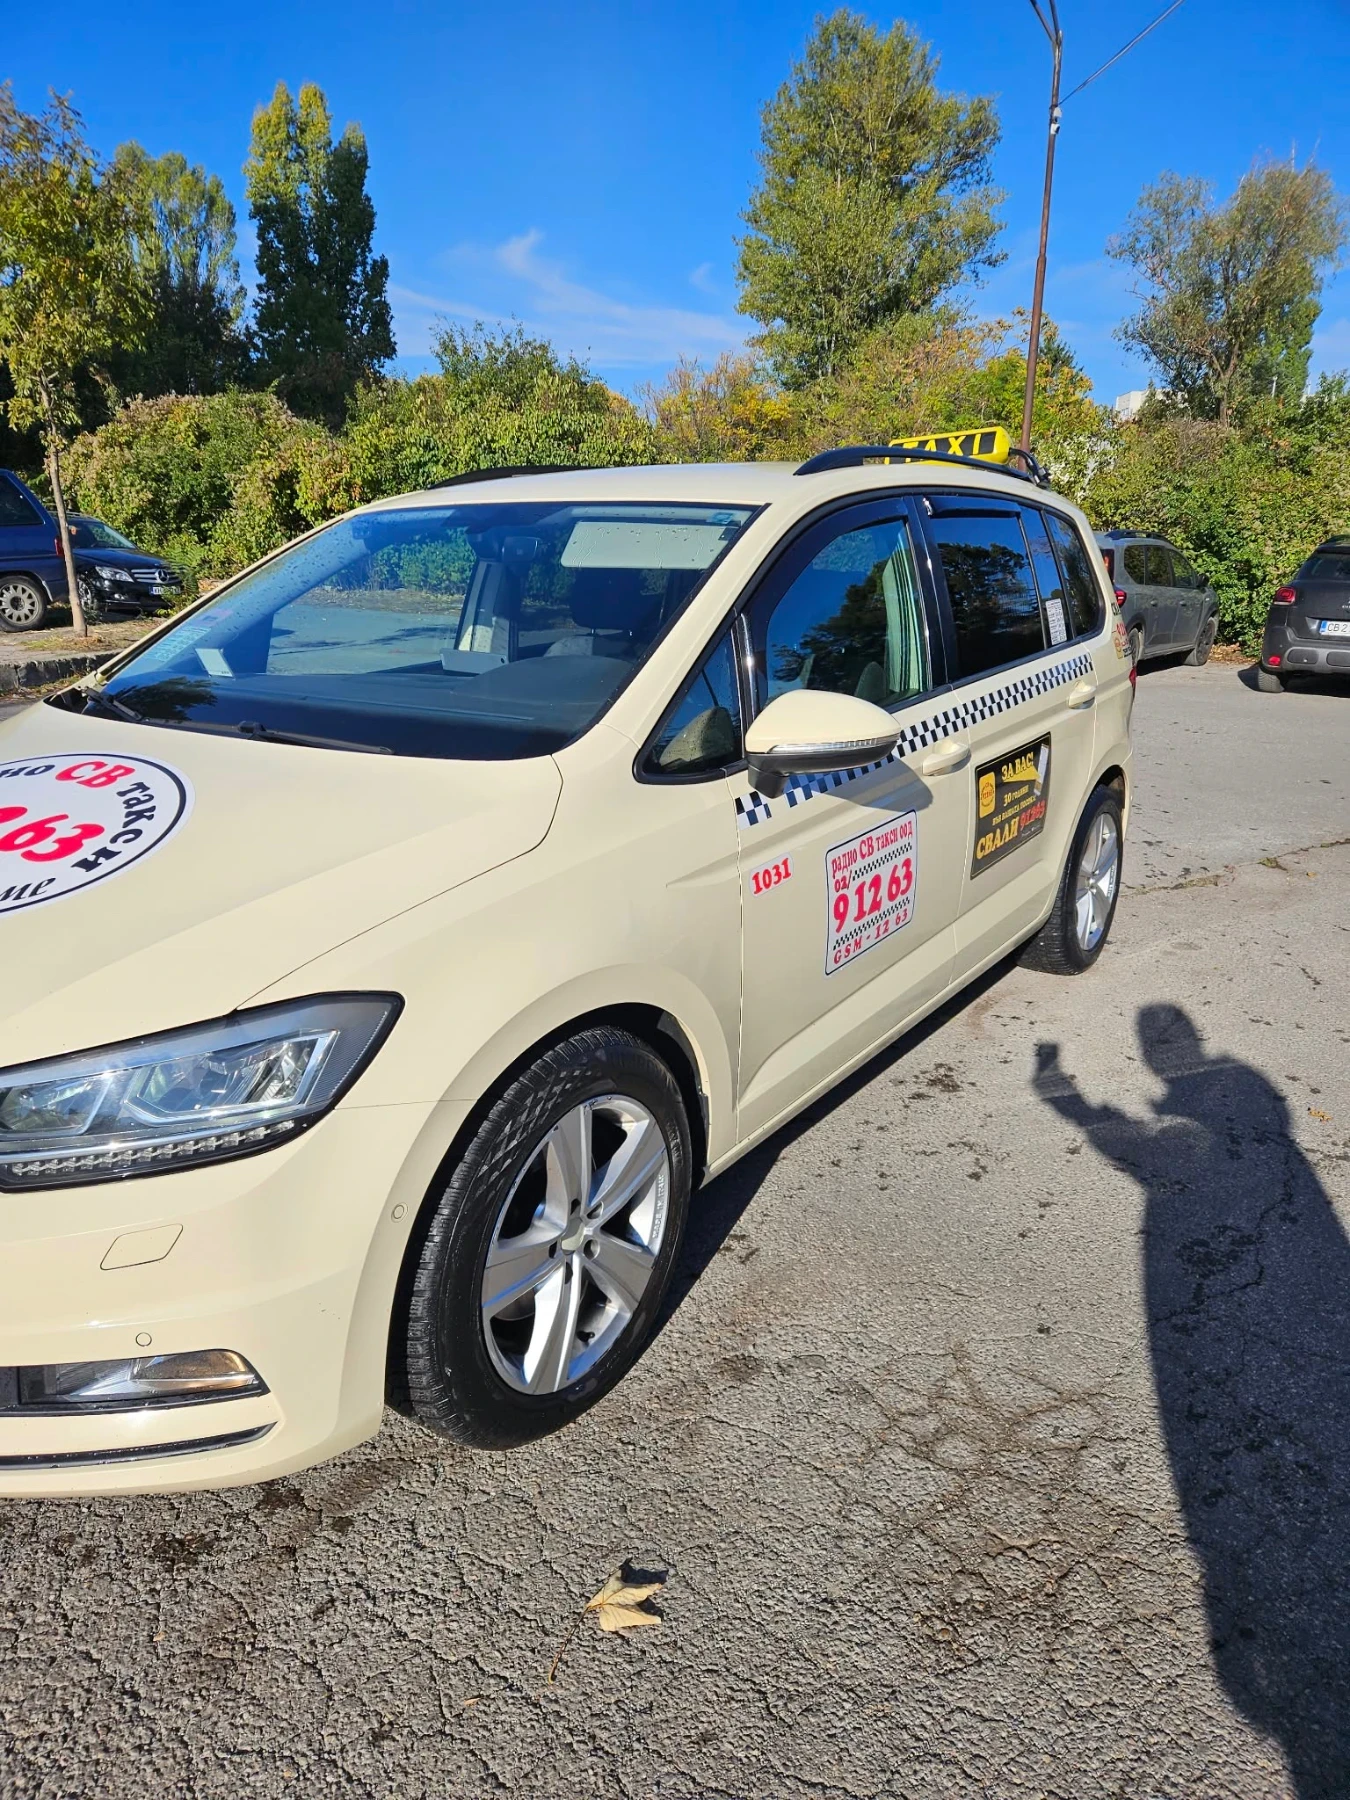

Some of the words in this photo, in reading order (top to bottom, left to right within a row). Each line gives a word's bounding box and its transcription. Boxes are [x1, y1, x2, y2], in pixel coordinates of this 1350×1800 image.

[1001, 762, 1013, 781] ЗА
[976, 816, 1020, 860] СВАЛИ
[751, 857, 792, 895] 1031
[833, 936, 862, 964] GSM
